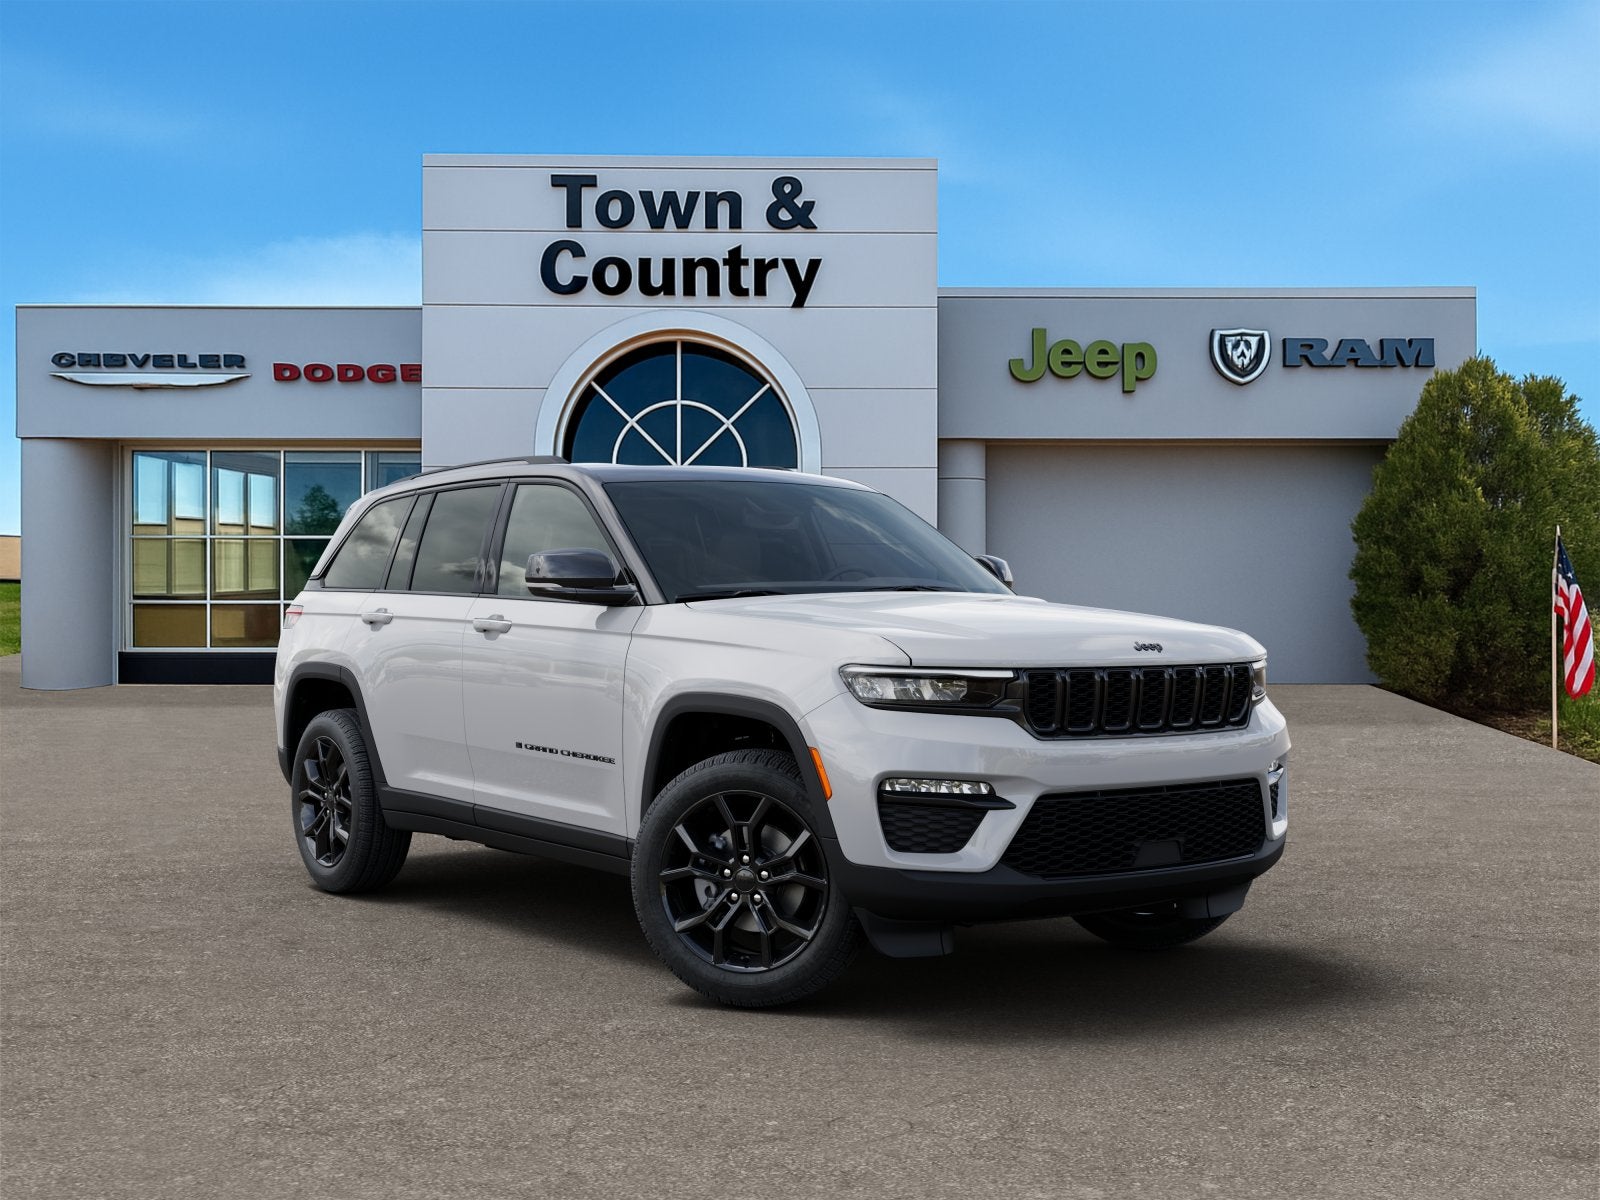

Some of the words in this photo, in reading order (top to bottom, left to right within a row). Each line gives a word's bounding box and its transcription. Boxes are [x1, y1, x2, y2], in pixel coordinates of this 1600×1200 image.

[550, 174, 743, 230] Town
[765, 175, 819, 230] &
[539, 239, 823, 309] Country
[1008, 328, 1158, 393] Jeep
[1282, 337, 1436, 368] RAM
[272, 362, 423, 384] DODGE
[1133, 641, 1163, 654] Jeep
[524, 743, 559, 755] GRAND
[560, 749, 616, 765] CHEROKEE
